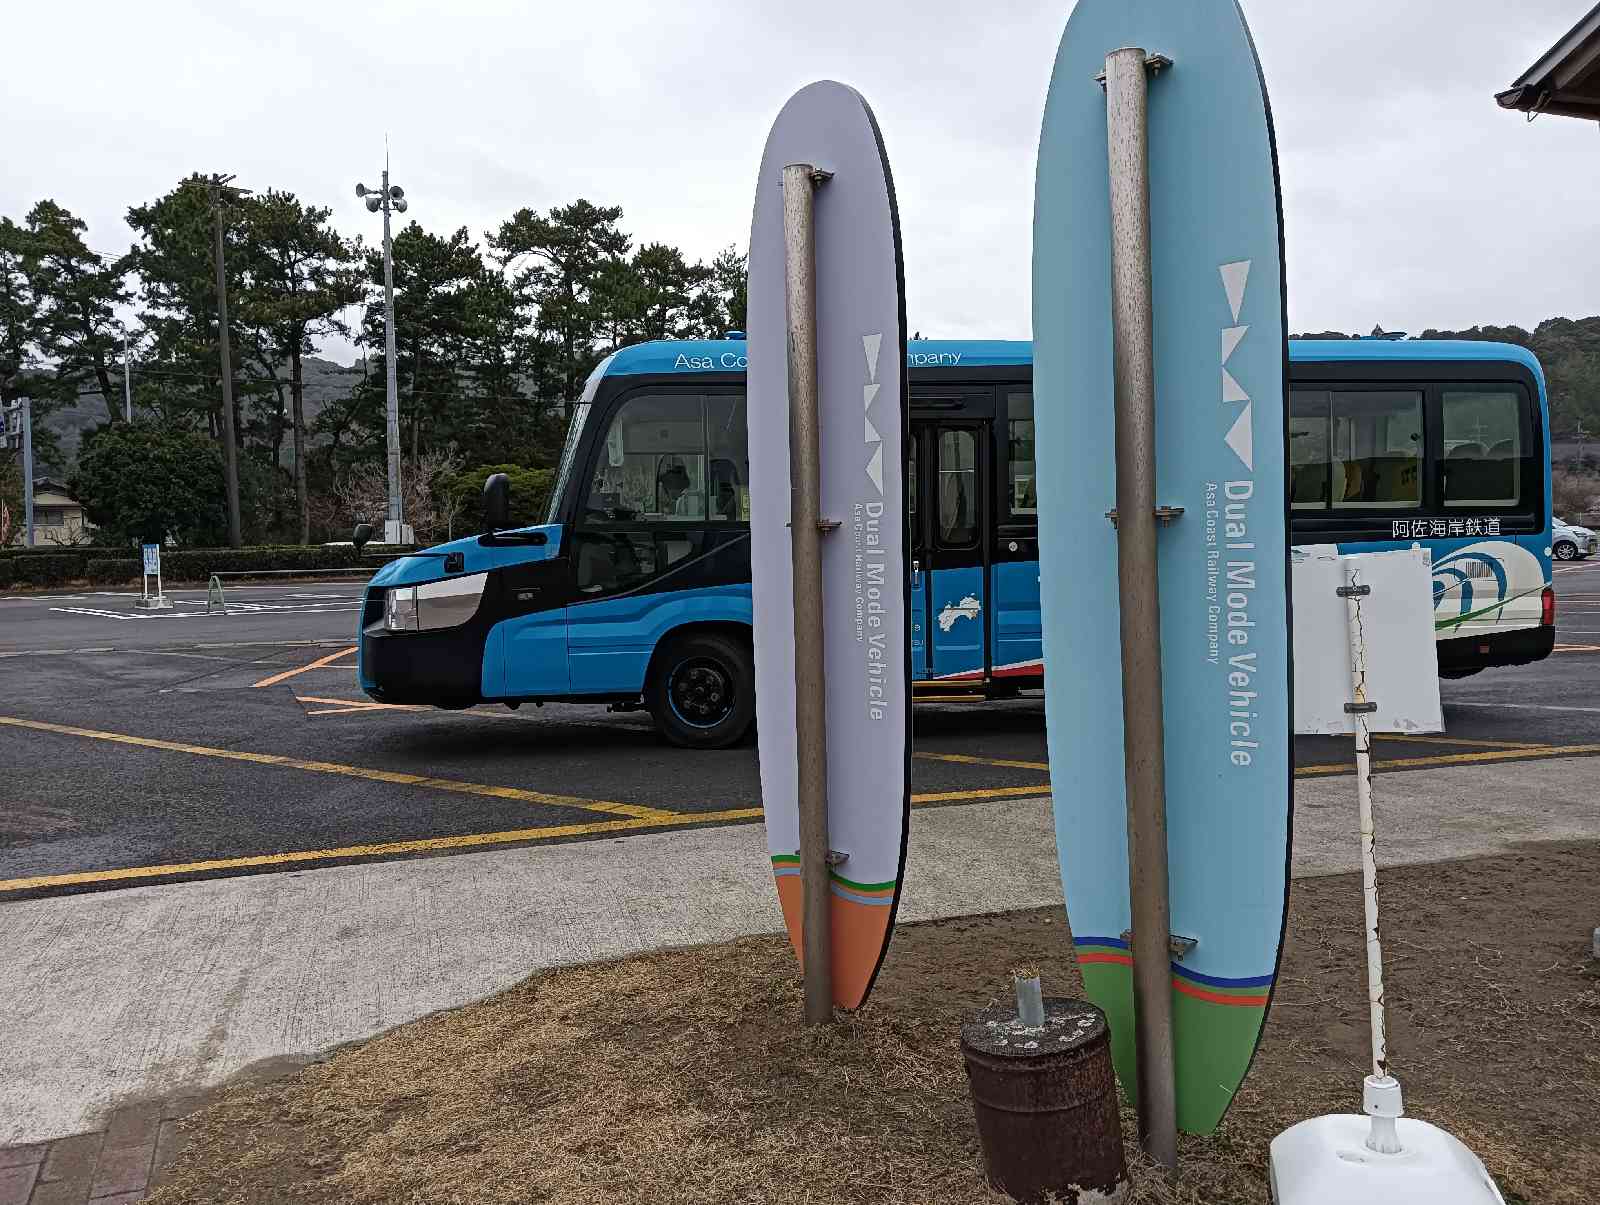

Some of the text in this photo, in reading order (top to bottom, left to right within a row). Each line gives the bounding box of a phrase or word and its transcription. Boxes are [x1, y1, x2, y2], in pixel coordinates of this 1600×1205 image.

[674, 353, 714, 369] Asa
[854, 503, 863, 522] Asa
[1392, 517, 1501, 538] 阿佐海岸鉄道
[1206, 482, 1220, 664] Asa Coast Railway Company
[855, 596, 864, 642] Company
[866, 502, 888, 720] Dual Mode Vehicle
[1224, 480, 1259, 765] Dual Mode Vehicle
